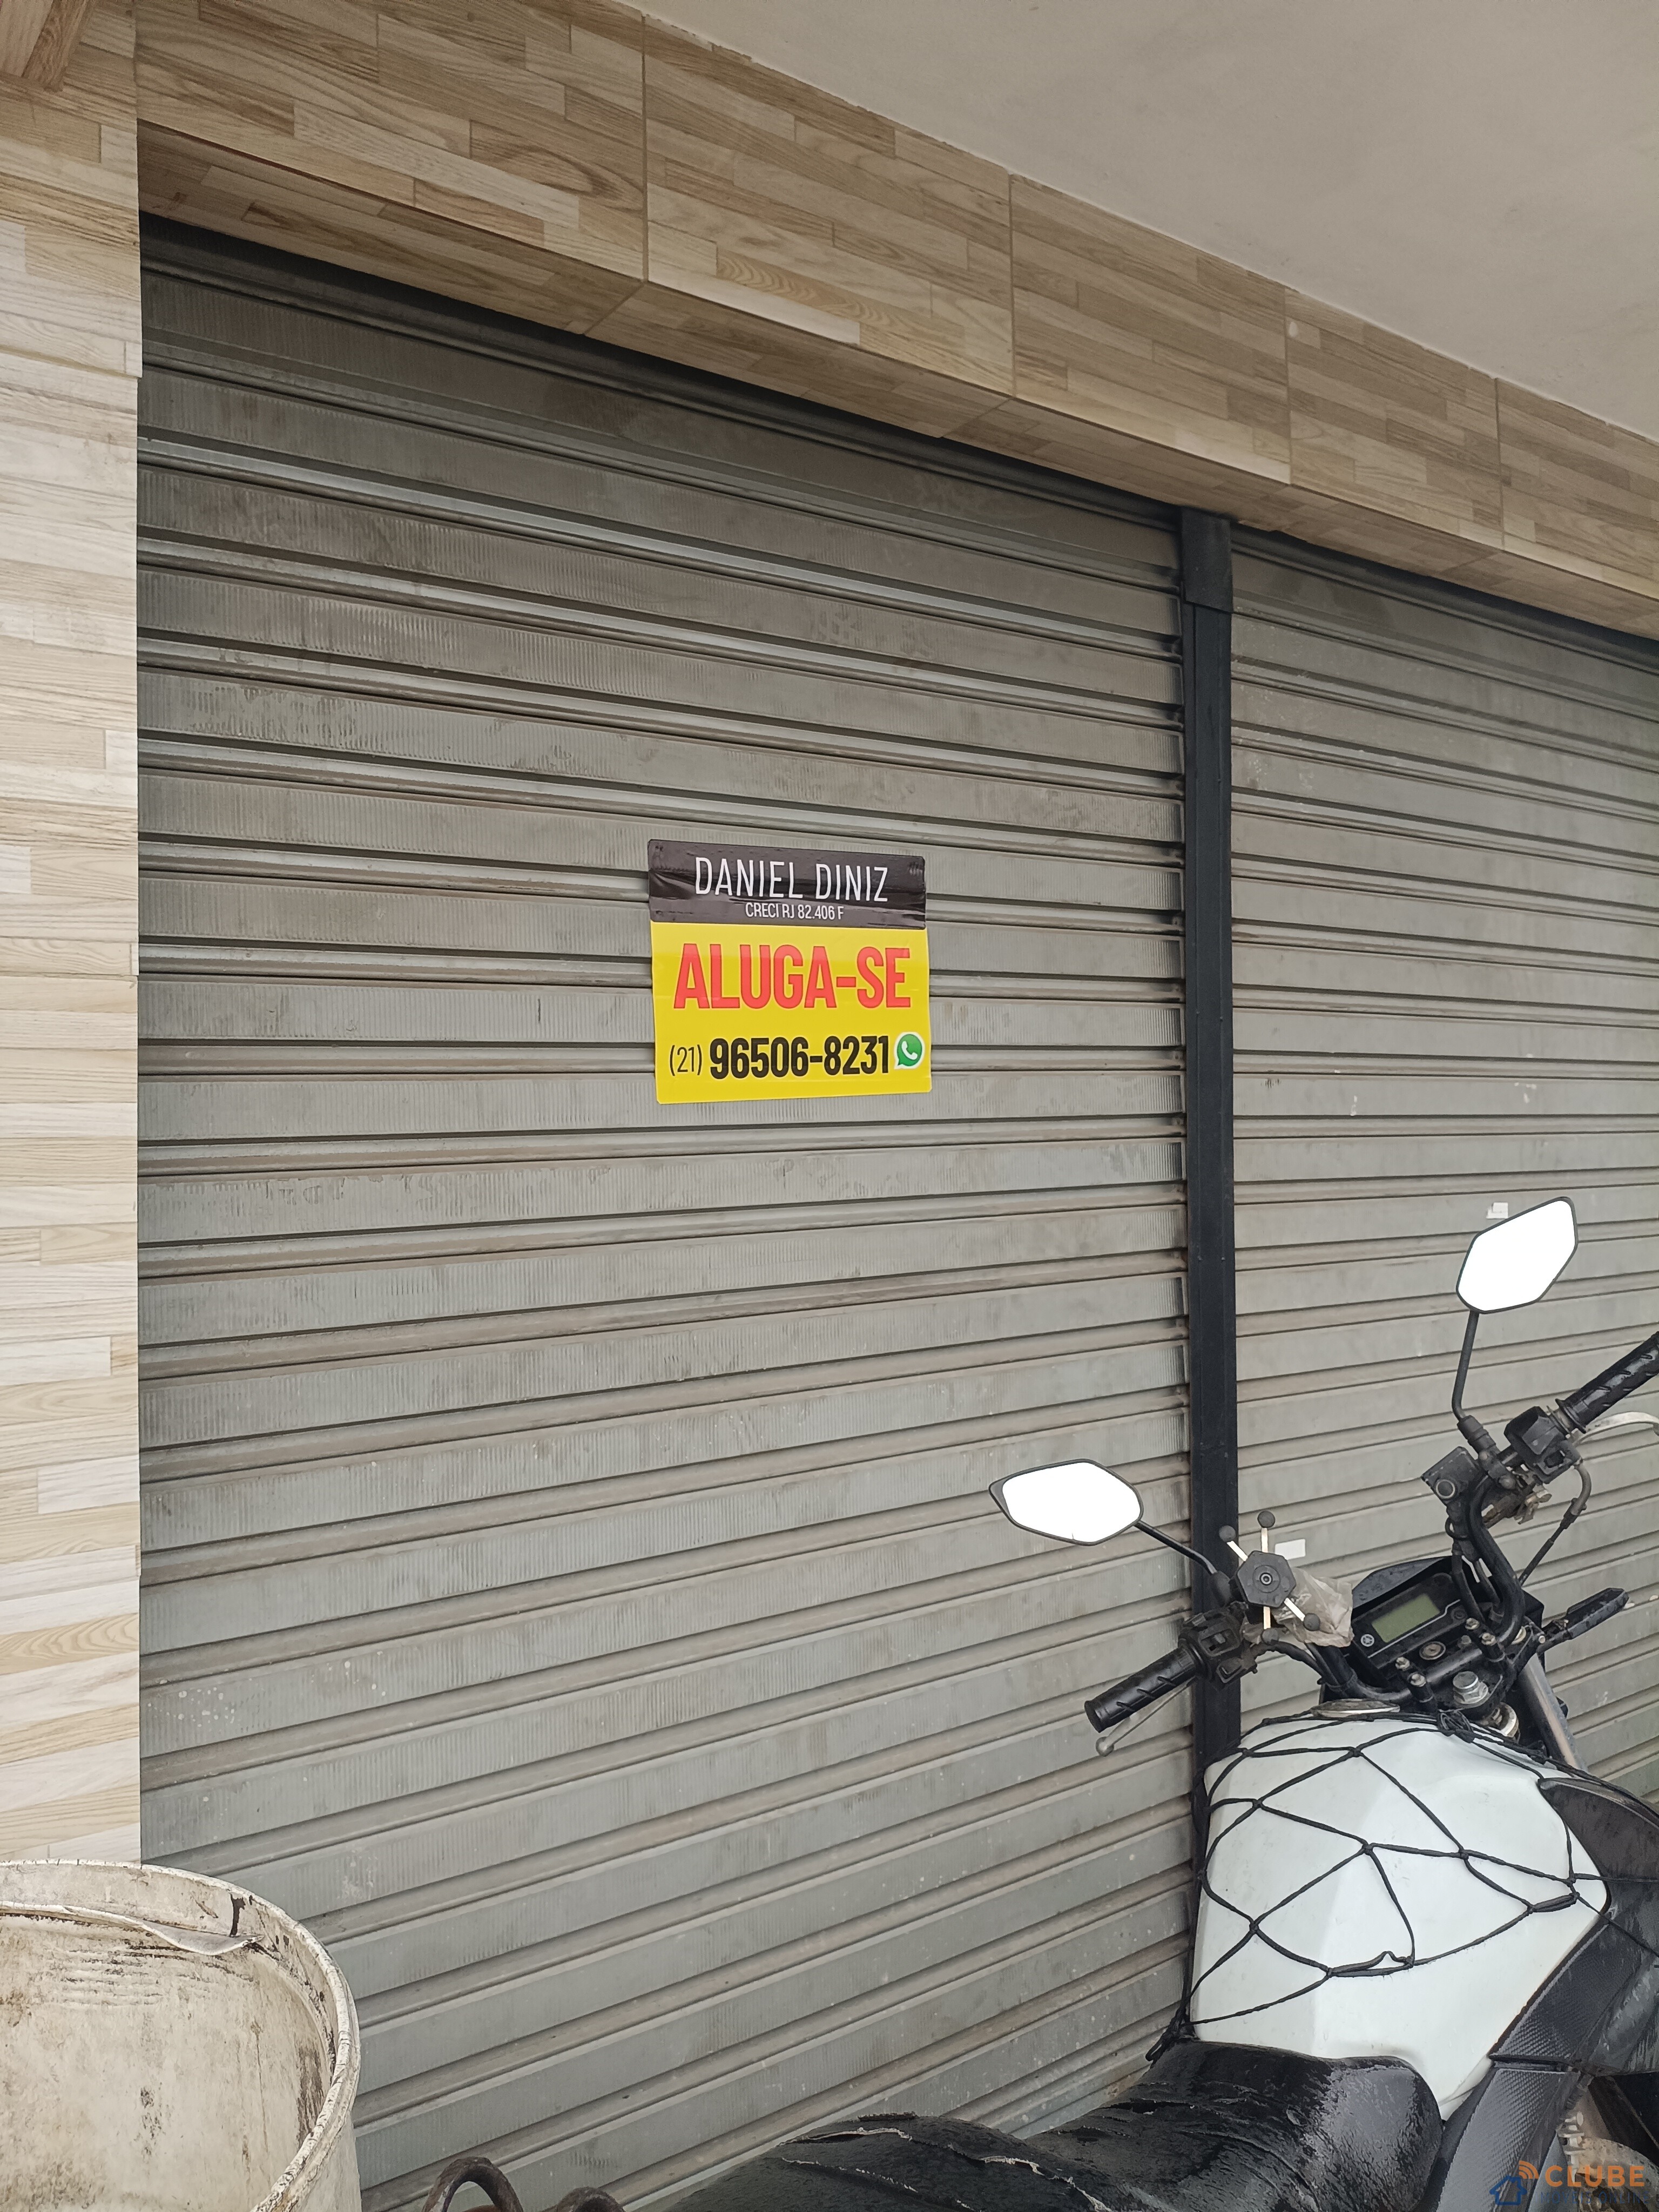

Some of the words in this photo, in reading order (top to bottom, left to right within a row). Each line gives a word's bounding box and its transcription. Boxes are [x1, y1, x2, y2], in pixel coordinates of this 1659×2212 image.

[694, 857, 803, 899] DANIEL
[815, 864, 888, 902] DINIZ
[745, 902, 779, 918] CRECI
[781, 903, 795, 919] RJ
[797, 904, 835, 920] 82.406
[837, 906, 844, 920] F
[673, 943, 912, 1009] ALUGA-SE
[669, 1044, 703, 1076] (21)
[709, 1035, 889, 1080] 96506-8231
